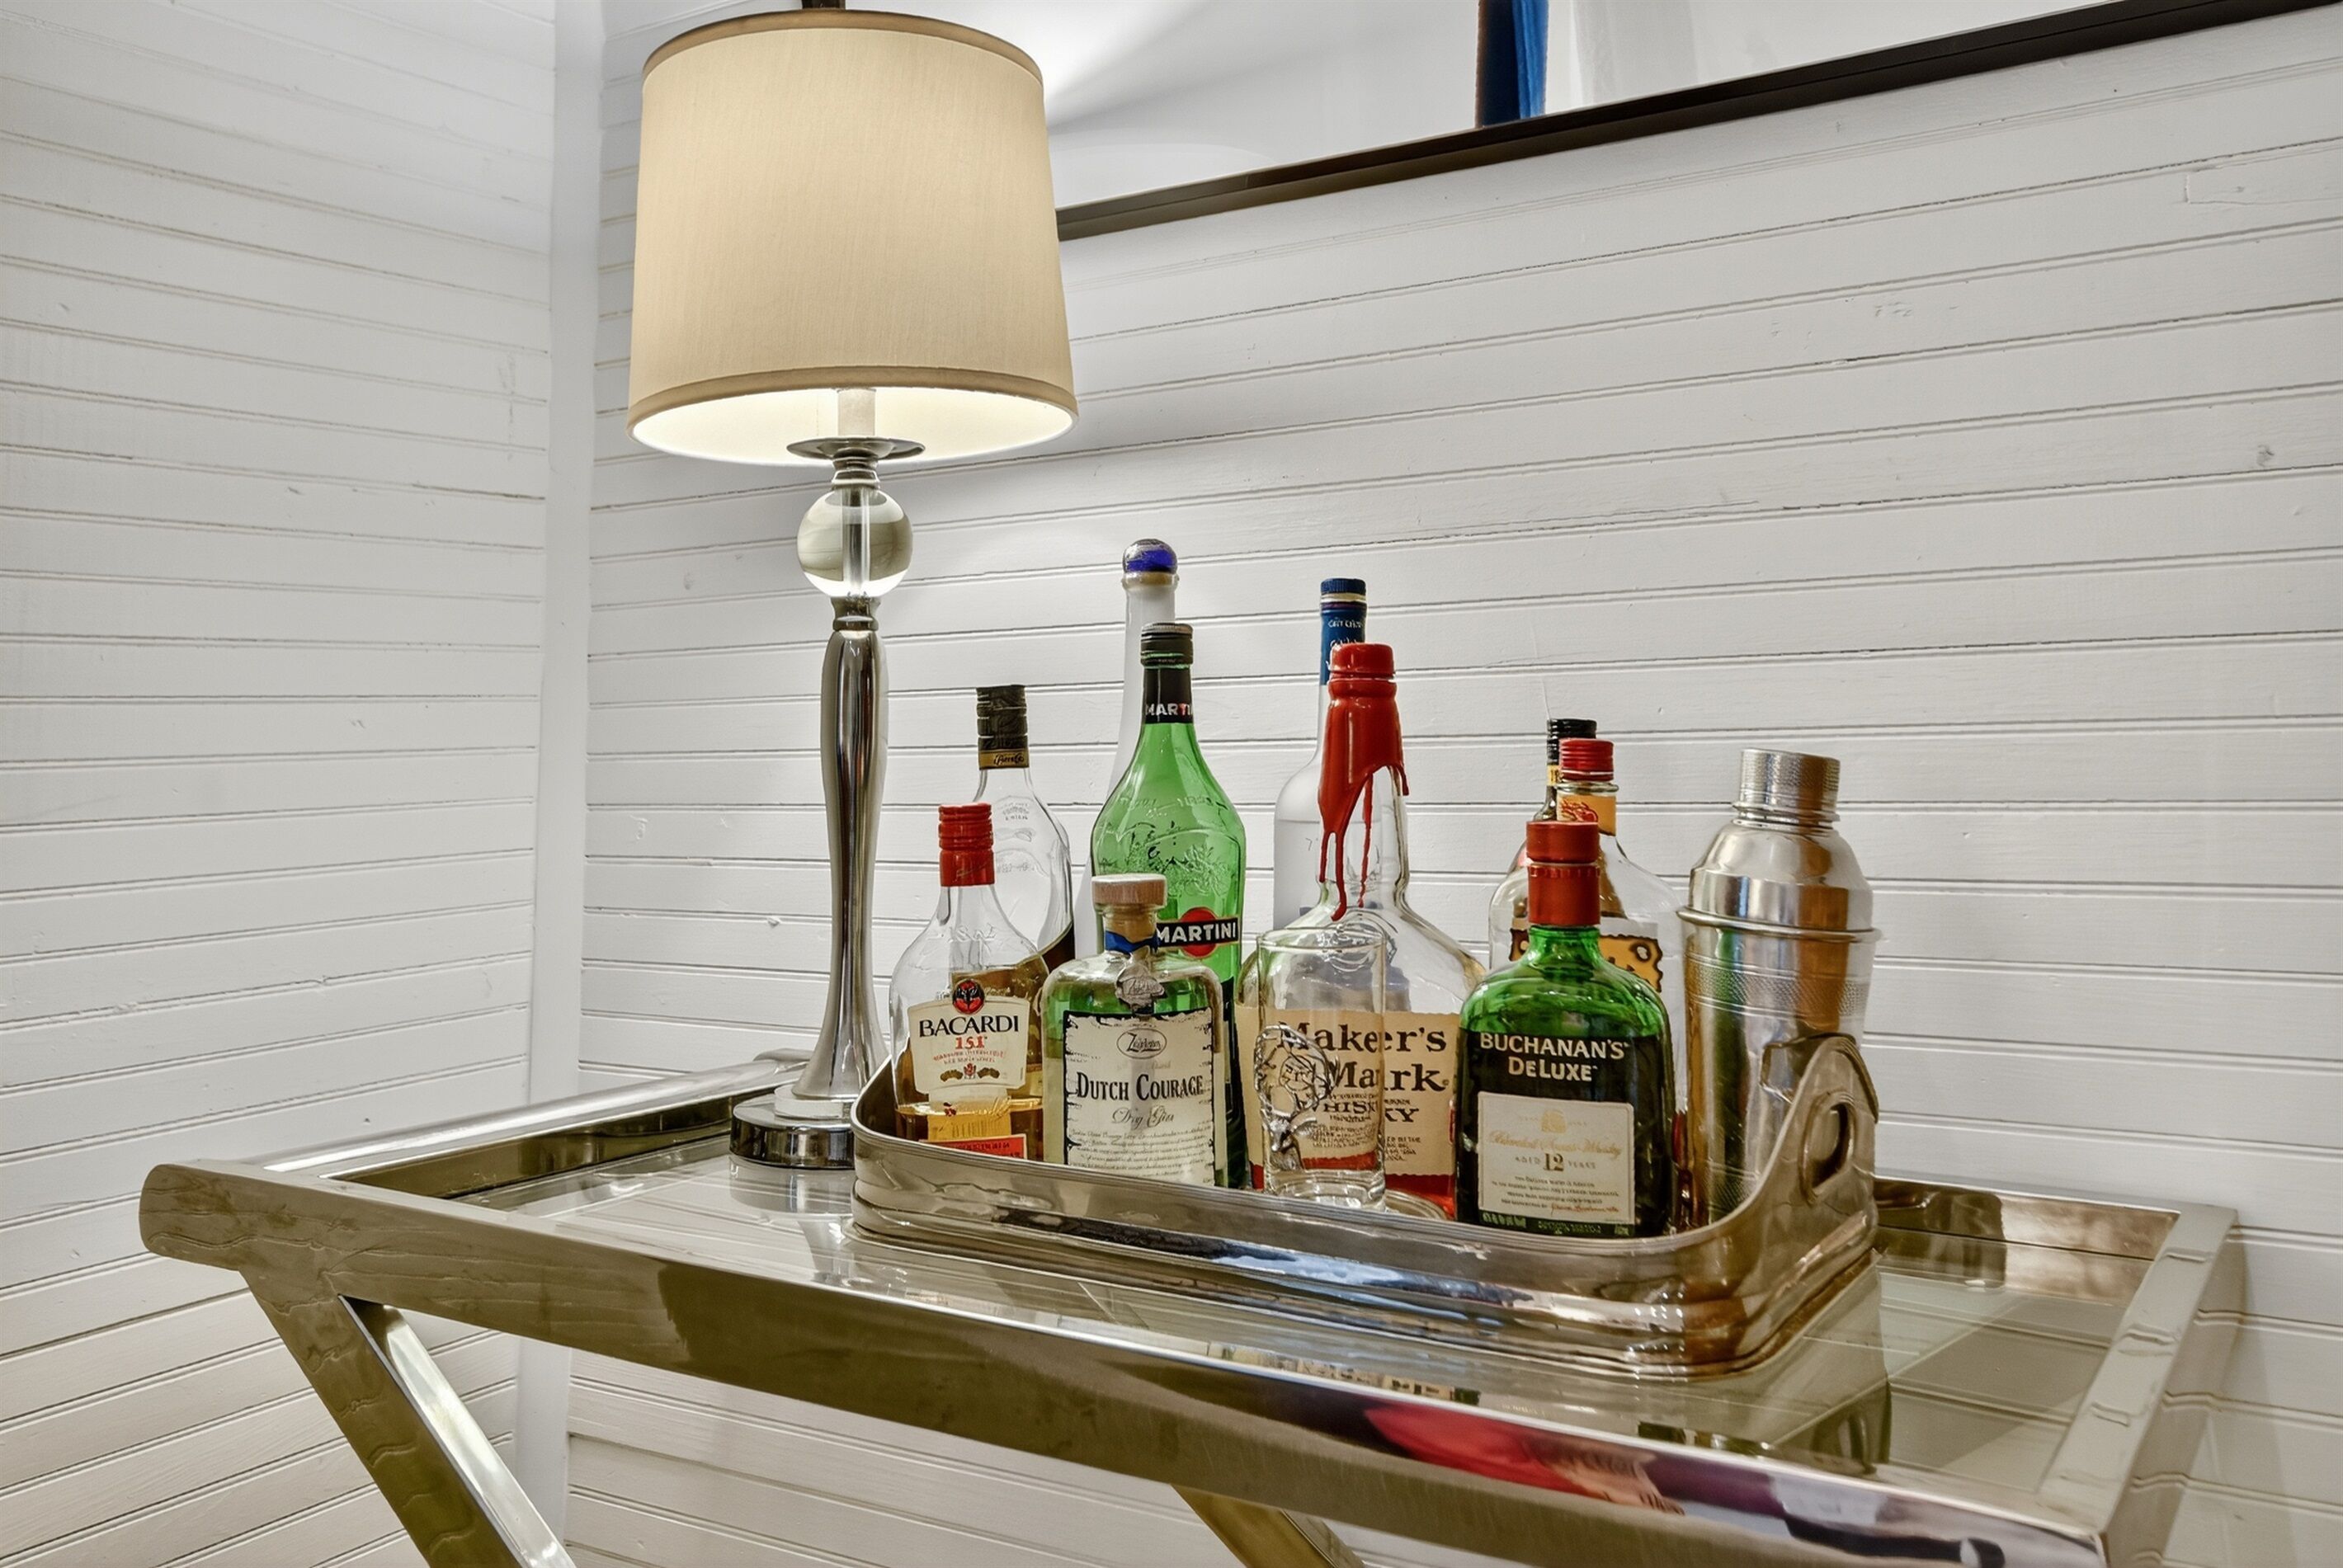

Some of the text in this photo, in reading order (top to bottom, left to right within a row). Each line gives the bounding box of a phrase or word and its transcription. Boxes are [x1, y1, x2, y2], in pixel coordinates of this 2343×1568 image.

[1145, 703, 1193, 716] MARTI
[1157, 921, 1237, 944] MARTINI
[919, 1015, 1020, 1038] BACARDI
[955, 1035, 984, 1049] 151
[1480, 1032, 1625, 1060] BUCHANAN'S
[1077, 1071, 1129, 1101] DUTCH
[1111, 1107, 1143, 1130] Dry
[1543, 1153, 1564, 1171] 12
